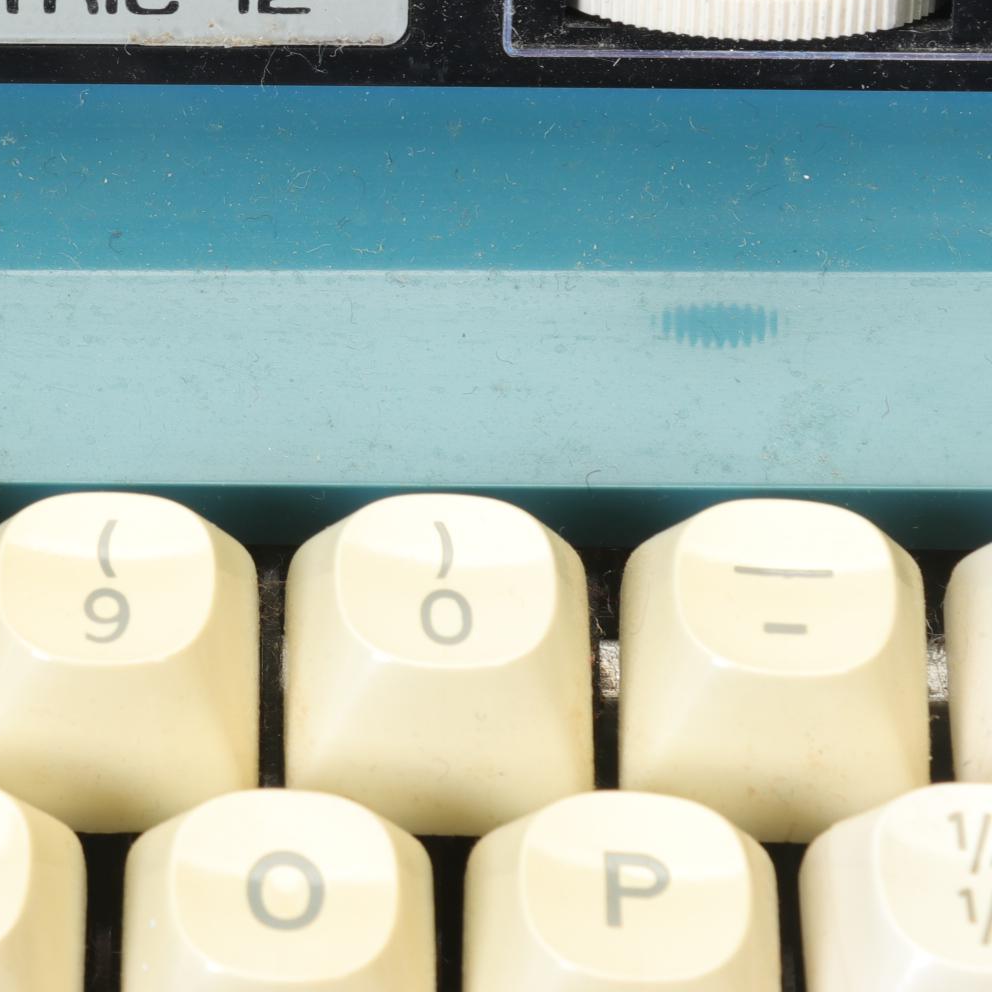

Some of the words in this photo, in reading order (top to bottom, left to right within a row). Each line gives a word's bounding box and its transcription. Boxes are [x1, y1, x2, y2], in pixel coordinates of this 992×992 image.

[97, 519, 119, 578] (
[433, 521, 454, 579] )
[83, 587, 131, 644] 9
[246, 850, 326, 931] O
[603, 851, 671, 928] P
